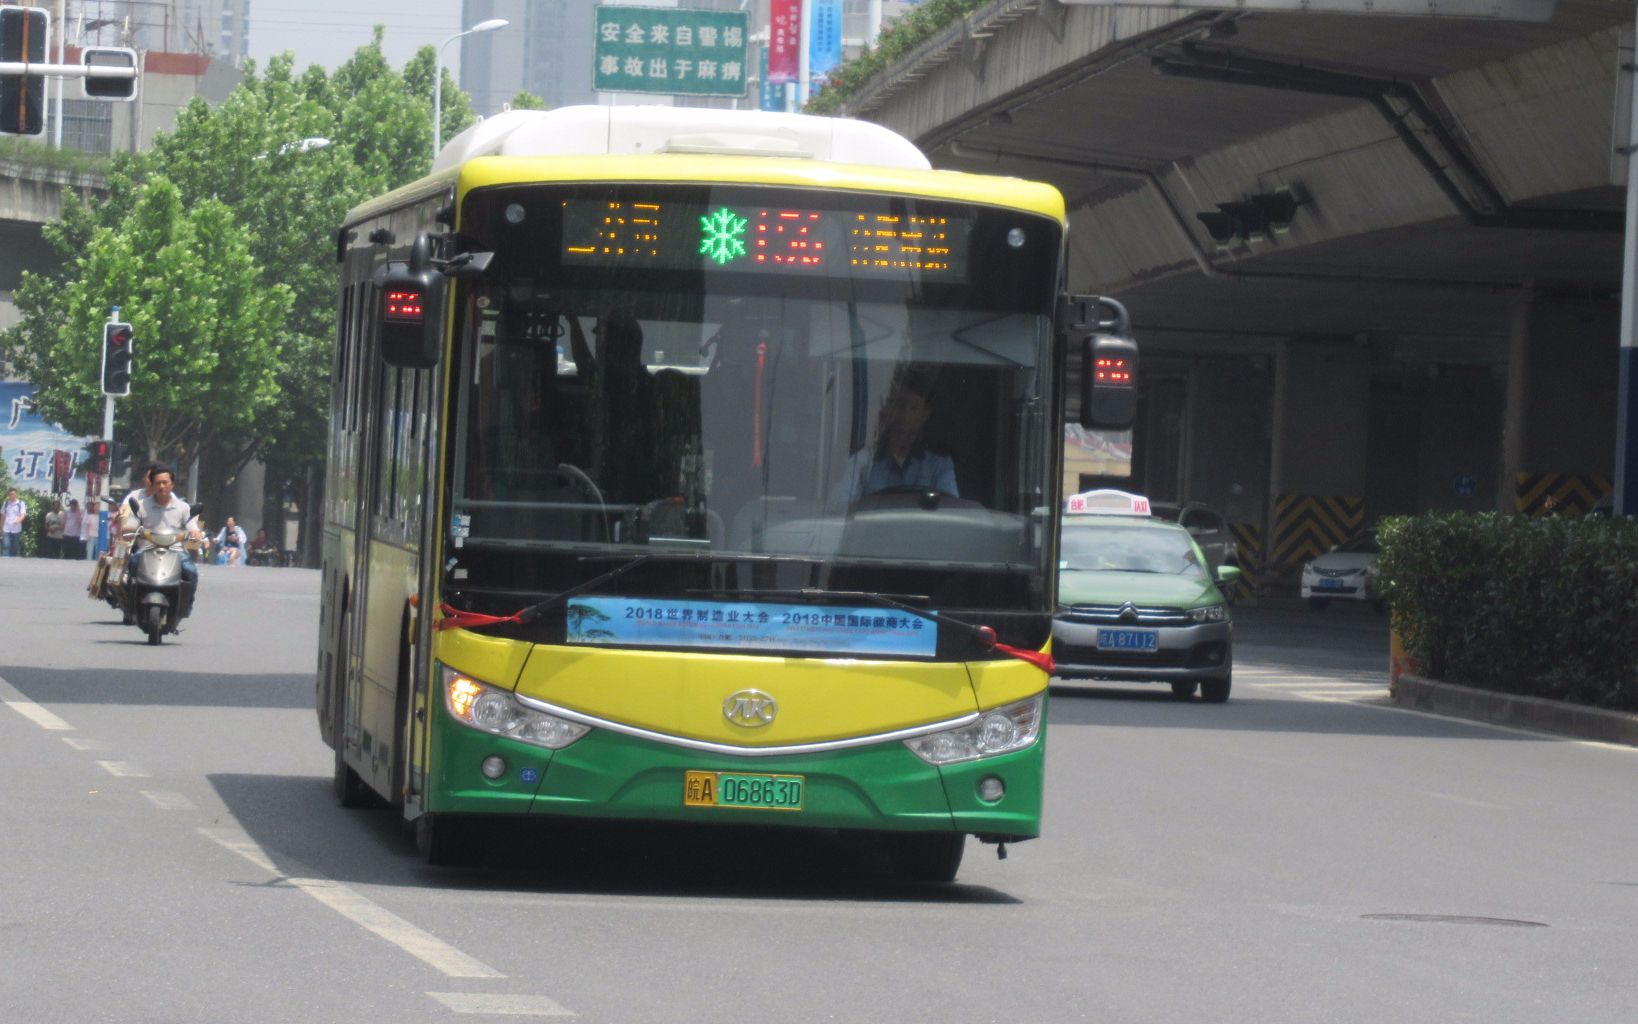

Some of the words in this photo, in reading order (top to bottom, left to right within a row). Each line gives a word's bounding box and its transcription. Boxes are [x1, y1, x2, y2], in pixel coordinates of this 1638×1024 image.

[601, 22, 742, 48] 安全来自警惕
[600, 55, 742, 81] 事故出于麻痹
[1134, 501, 1148, 513] TAXI
